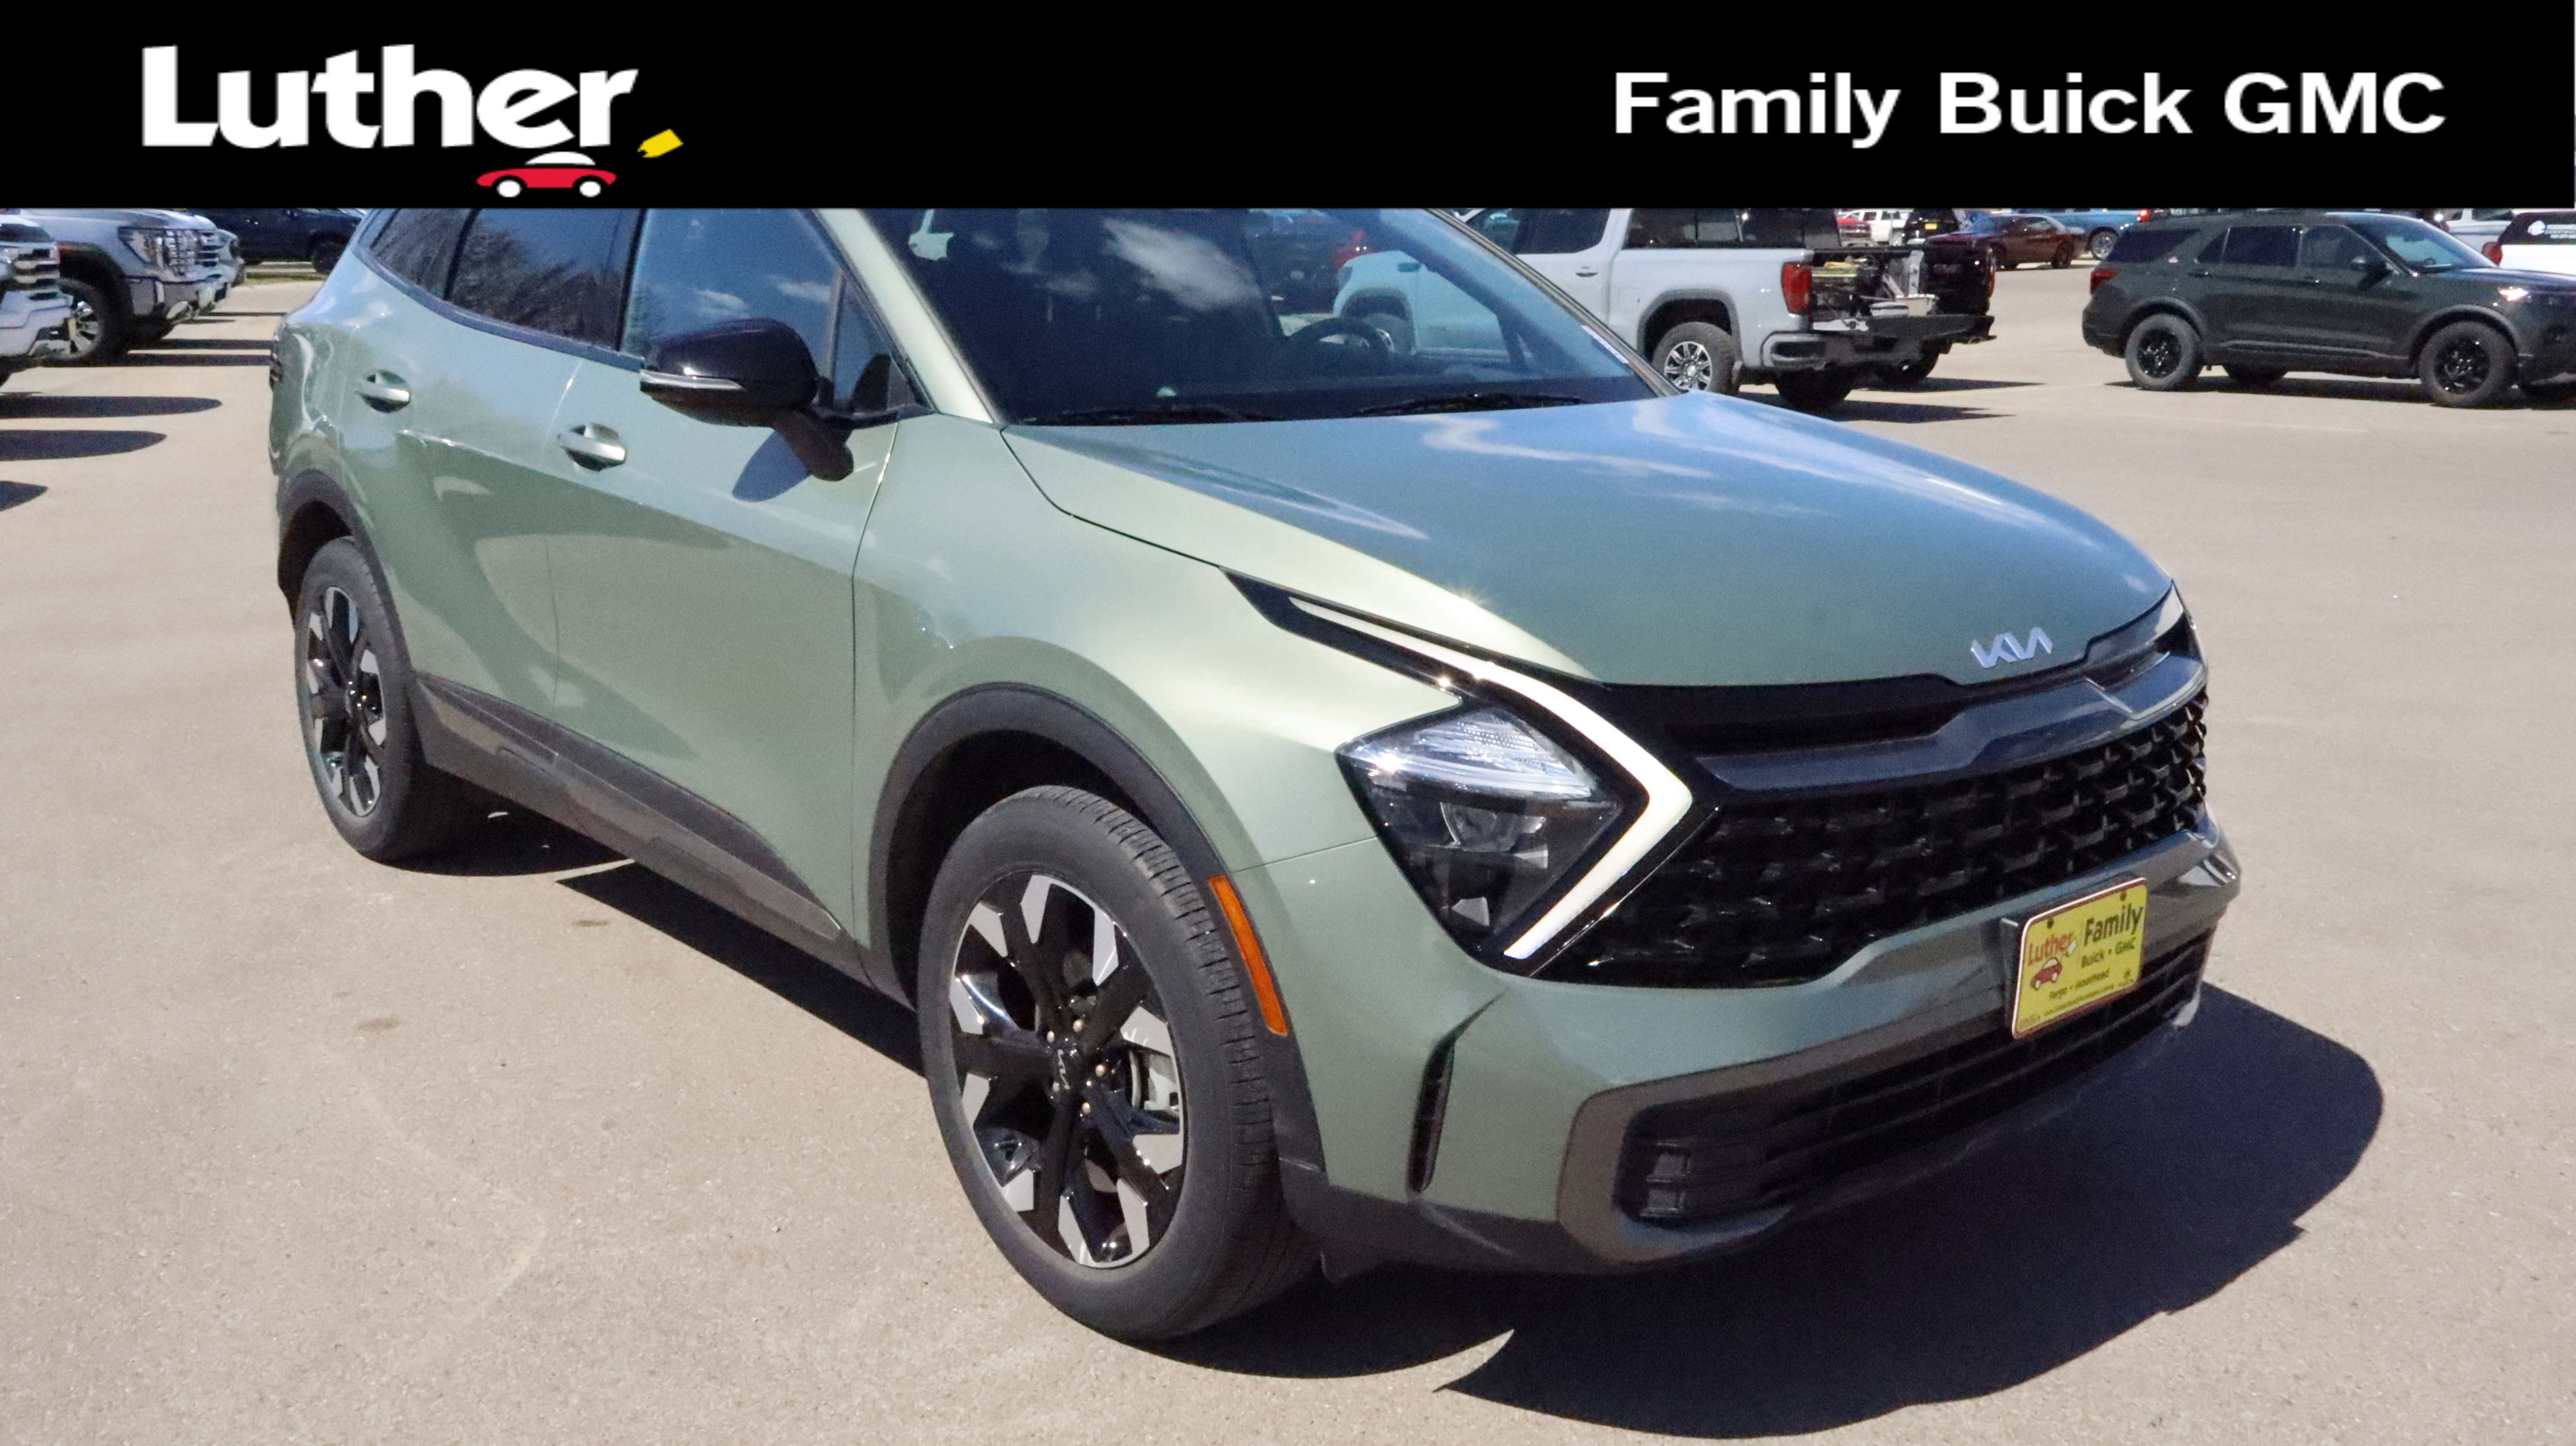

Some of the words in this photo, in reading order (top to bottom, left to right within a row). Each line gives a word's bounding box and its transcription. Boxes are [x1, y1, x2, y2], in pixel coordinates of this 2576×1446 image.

[2084, 903, 2144, 946] Family
[2028, 932, 2073, 966] Luther
[2081, 950, 2105, 968] Buick
